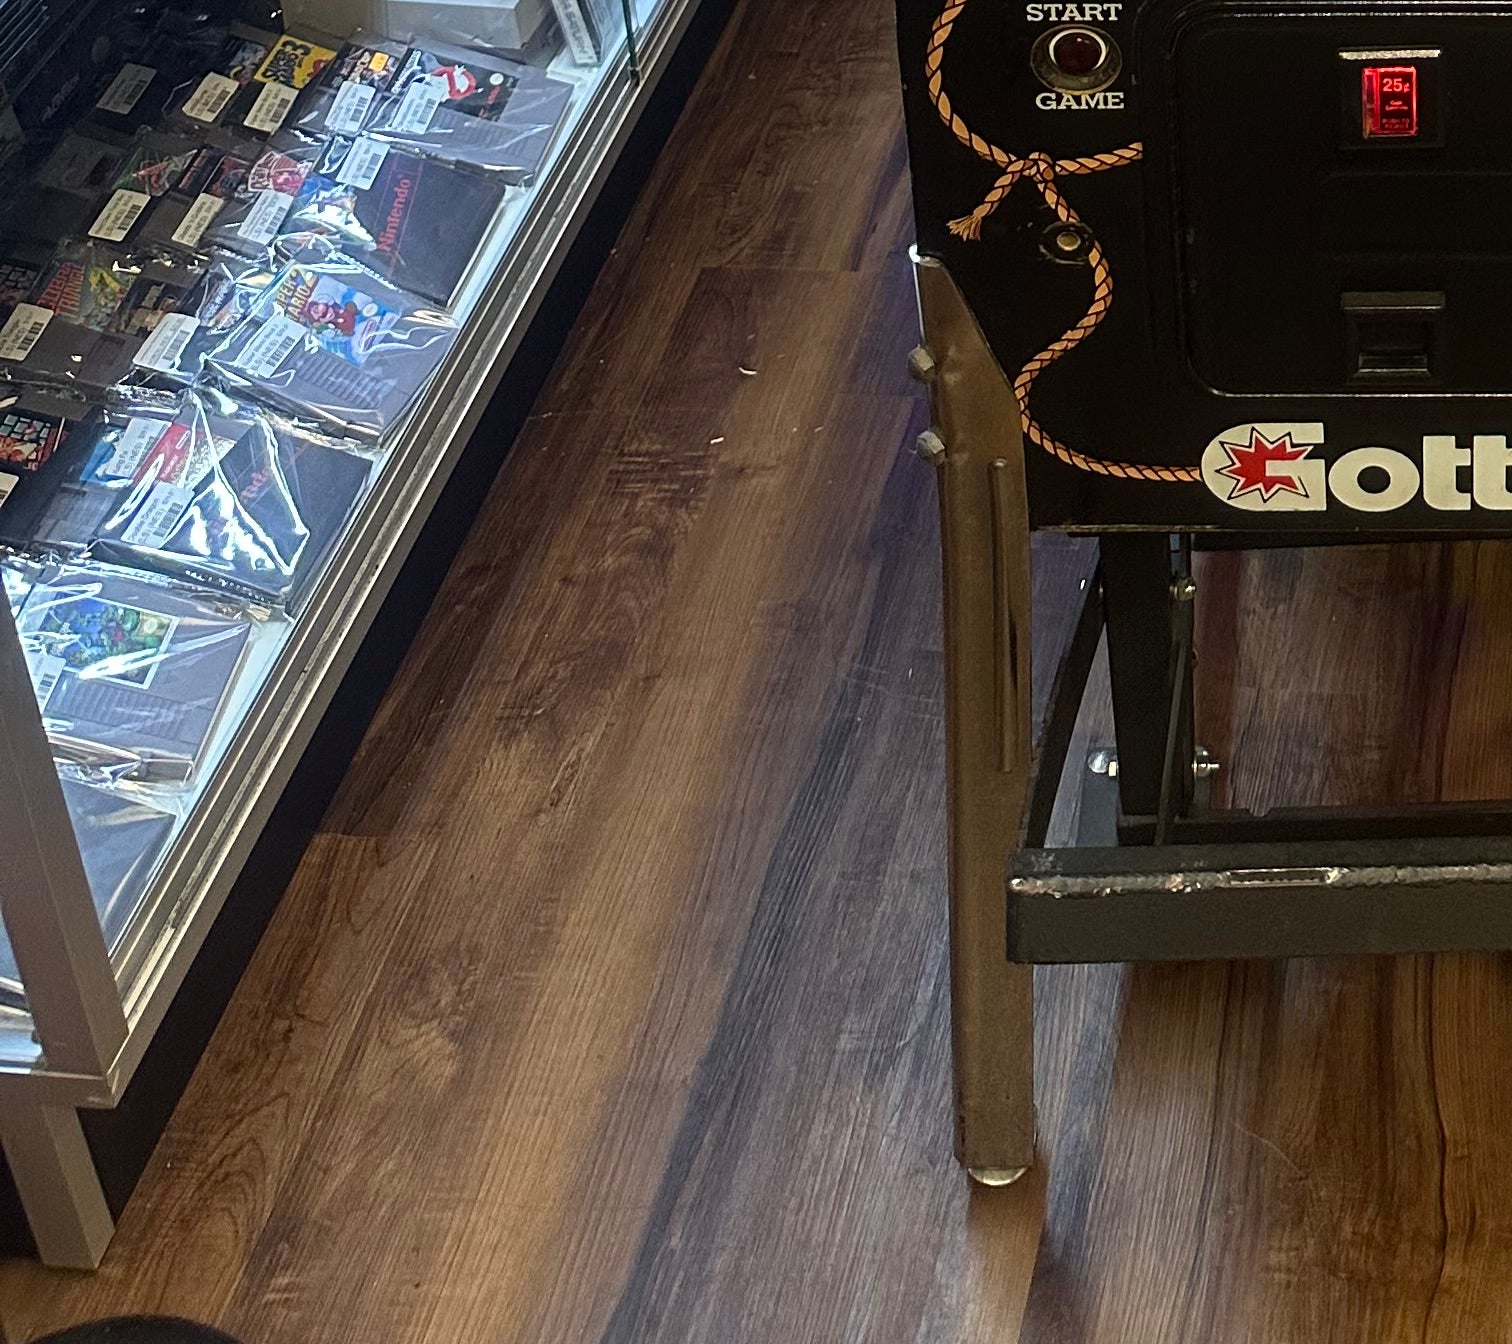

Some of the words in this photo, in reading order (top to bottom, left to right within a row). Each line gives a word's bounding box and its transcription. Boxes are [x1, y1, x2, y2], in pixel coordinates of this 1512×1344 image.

[1026, 3, 1122, 21] START
[1382, 77, 1410, 93] 25¢
[1036, 93, 1124, 110] GAME
[378, 177, 413, 253] Nintendo
